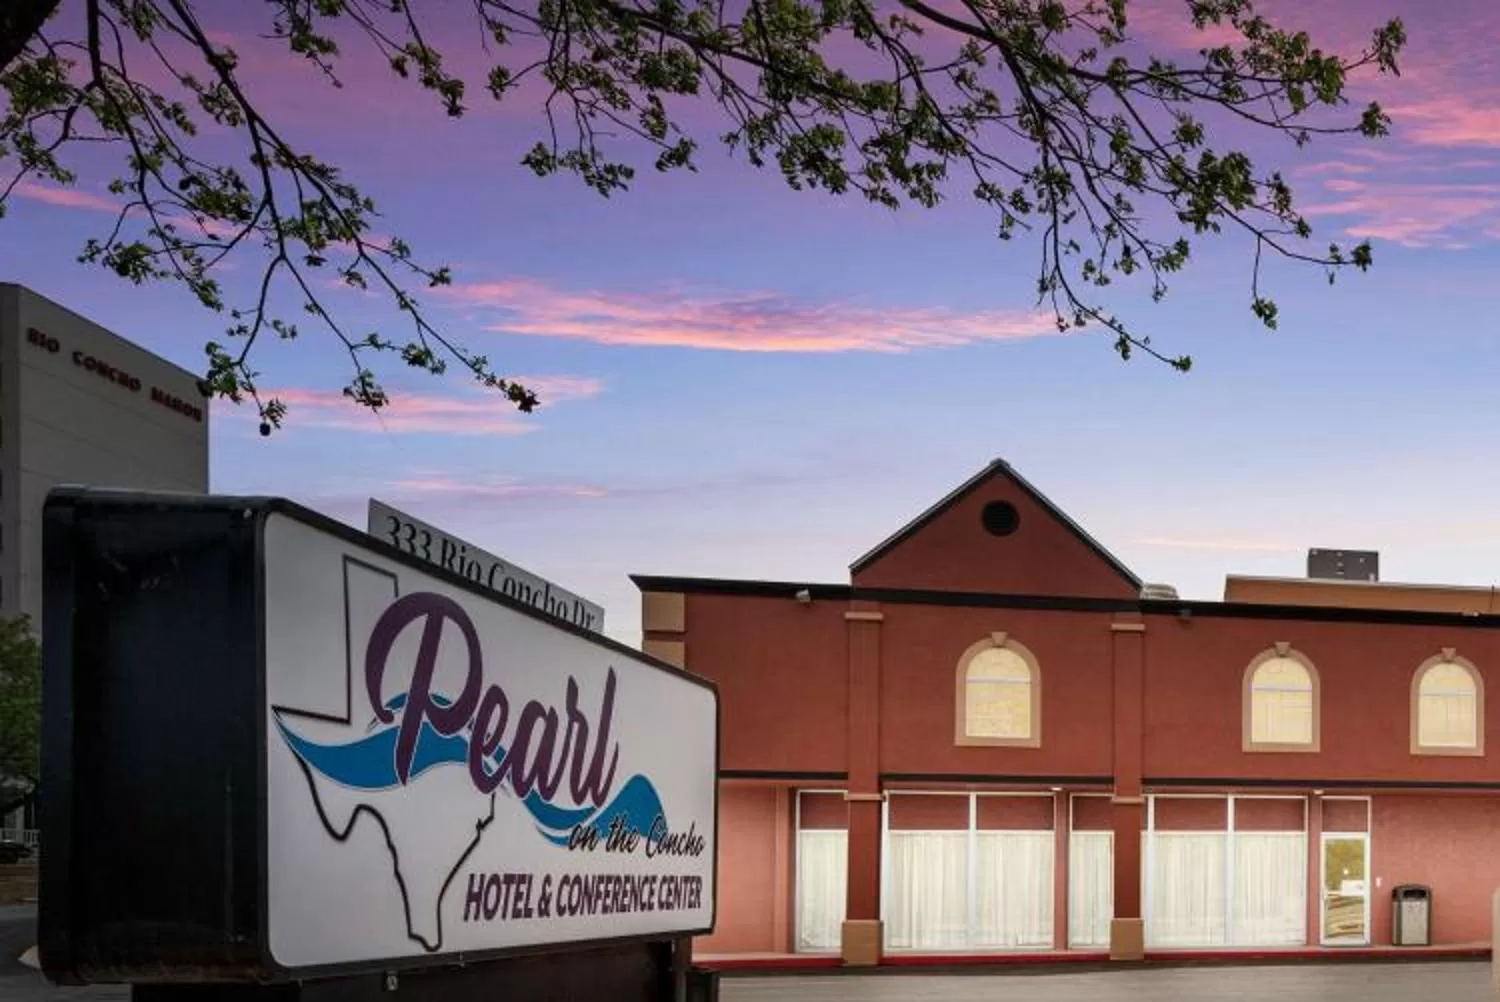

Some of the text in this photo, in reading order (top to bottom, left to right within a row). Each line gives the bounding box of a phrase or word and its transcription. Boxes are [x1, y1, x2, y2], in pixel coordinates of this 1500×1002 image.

[26, 327, 60, 353] RIO
[72, 351, 141, 392] CONCHO
[386, 515, 432, 560] 333
[441, 538, 482, 581] Rio
[364, 591, 619, 808] Pearl
[568, 813, 706, 859] on the Concho
[463, 873, 702, 922] HOTEL & CONFERENCE CENTER
